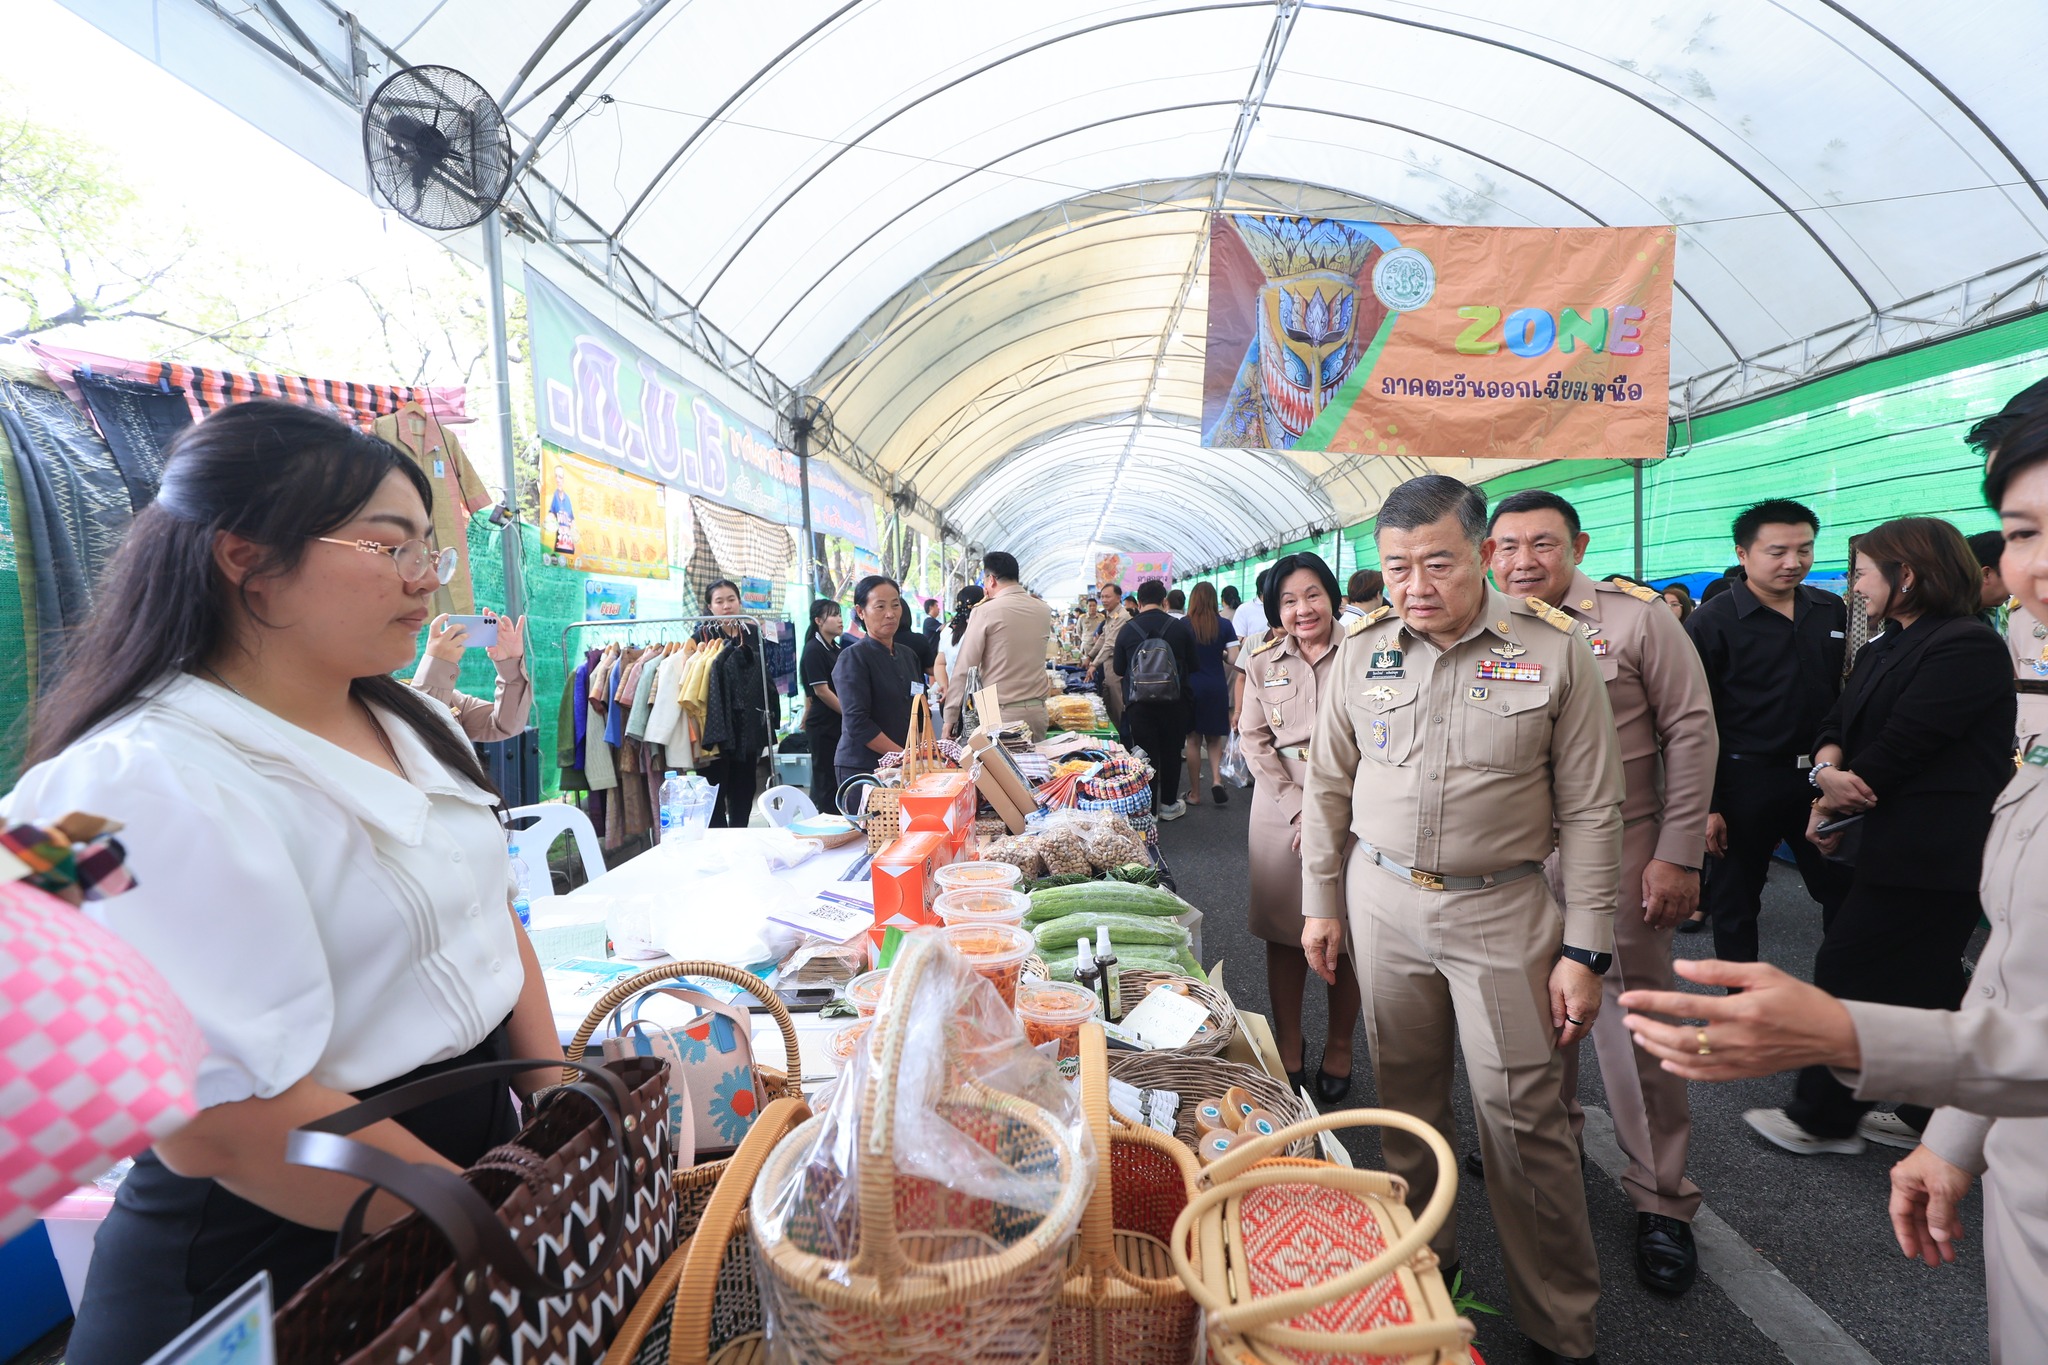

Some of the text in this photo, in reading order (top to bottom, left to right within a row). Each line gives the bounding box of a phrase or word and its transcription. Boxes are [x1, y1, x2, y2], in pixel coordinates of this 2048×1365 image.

[1455, 305, 1646, 358] ZONE
[1382, 370, 1644, 403] ภาคตะวันออกเฉียงเหนือ
[1136, 563, 1168, 572] ZONE
